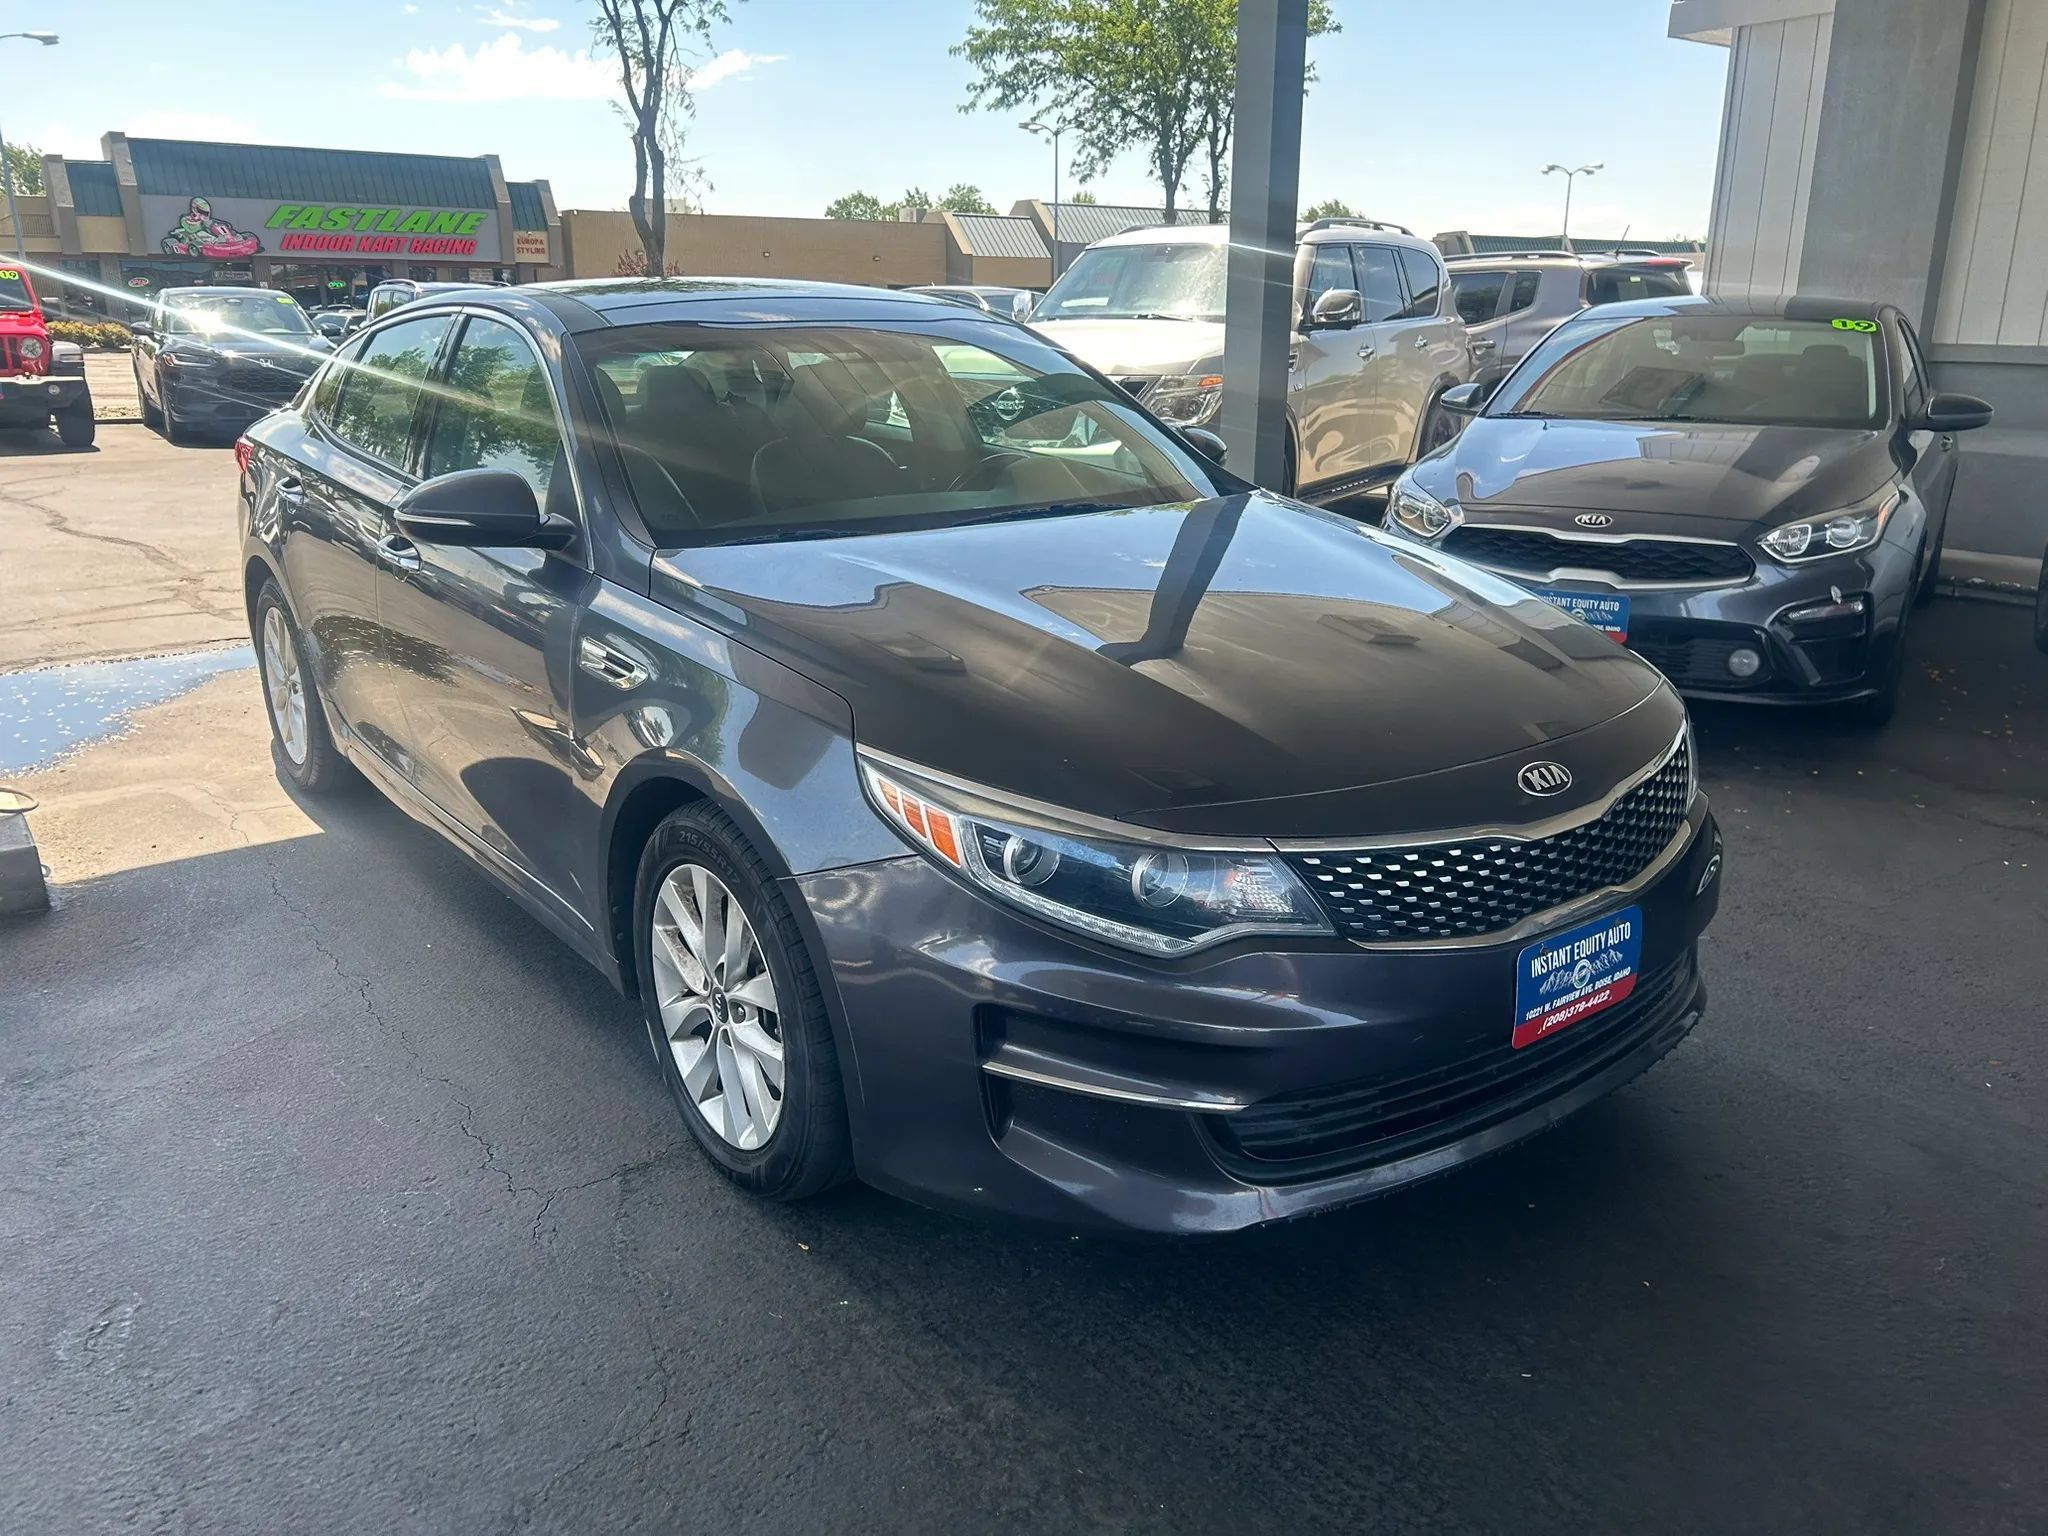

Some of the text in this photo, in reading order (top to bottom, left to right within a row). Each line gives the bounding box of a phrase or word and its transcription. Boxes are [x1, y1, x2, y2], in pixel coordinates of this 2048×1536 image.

[264, 204, 488, 234] FASTLANE
[280, 233, 478, 256] INDOOR KART RACING
[516, 247, 546, 255] STYLING
[1581, 515, 1606, 525] KIA
[1572, 598, 1599, 610] EQUITY
[1600, 600, 1620, 612] AUTO
[1524, 765, 1569, 791] KIA
[1531, 921, 1631, 979] INSTANT EQUITY AUTO
[1525, 1006, 1543, 1021] 10221
[1552, 988, 1581, 1009] FAIRVIEW
[1613, 966, 1631, 981] IDAHO
[1542, 989, 1611, 1031] (208)378-4422
